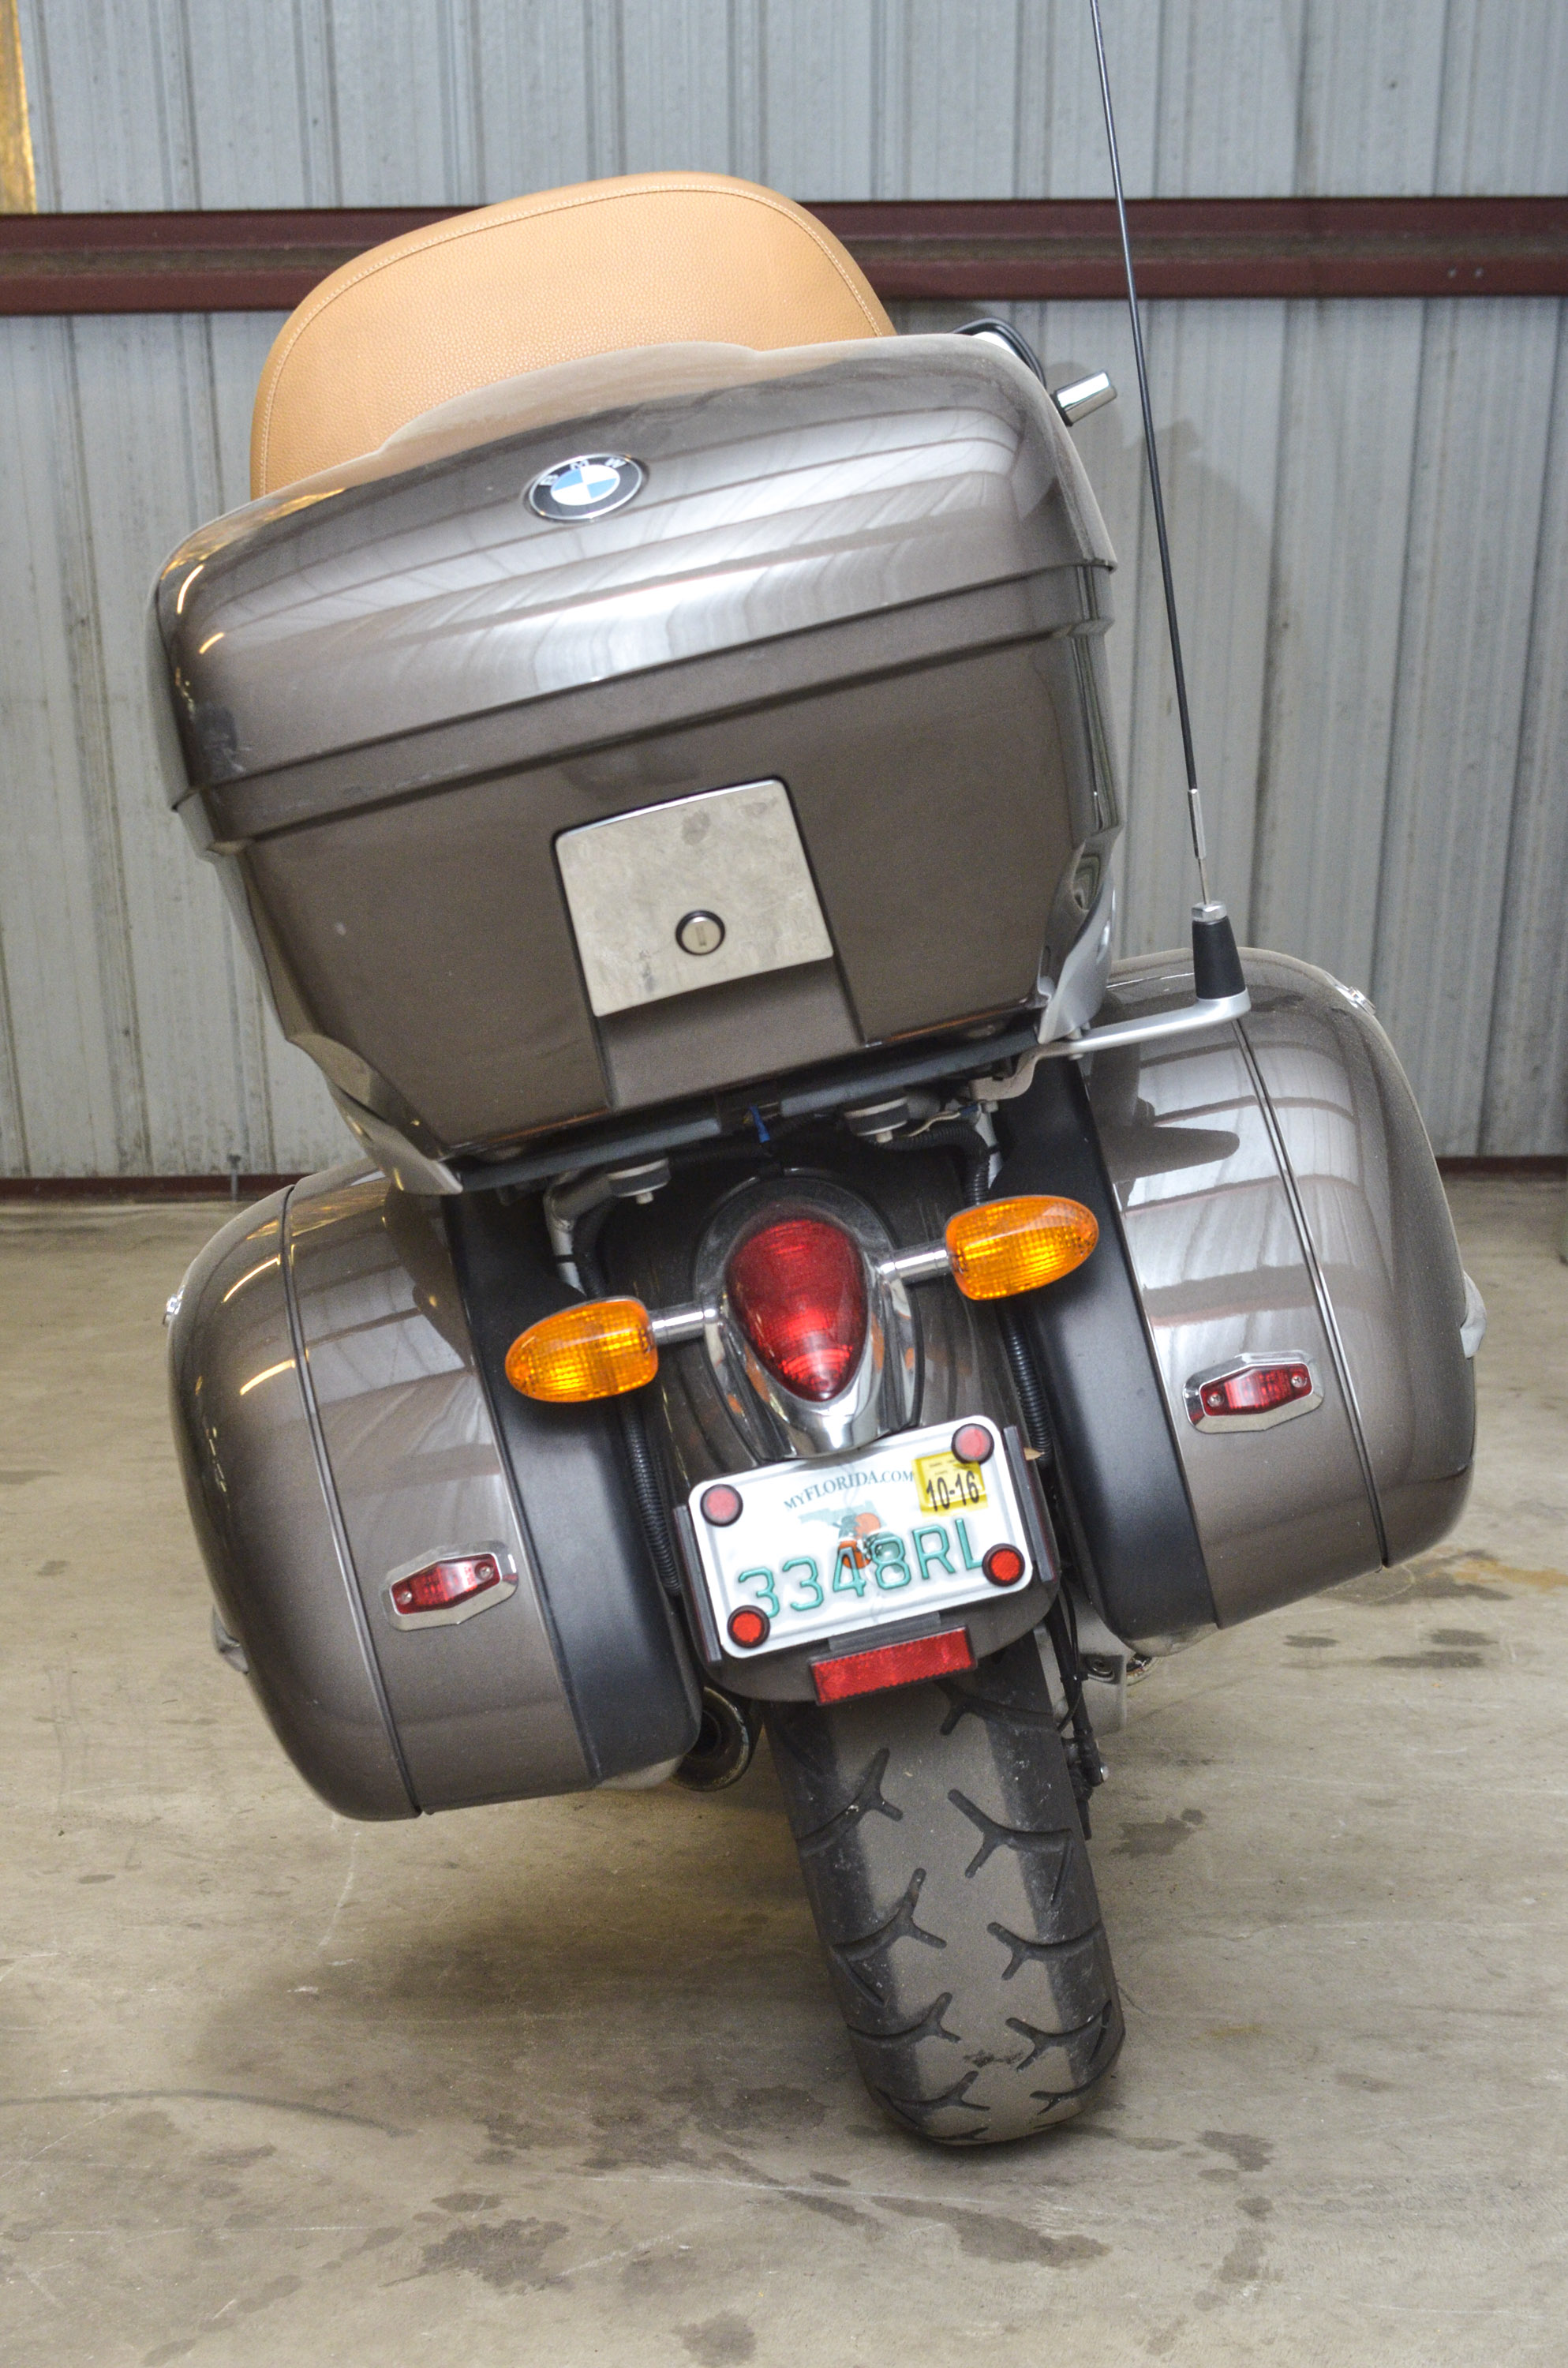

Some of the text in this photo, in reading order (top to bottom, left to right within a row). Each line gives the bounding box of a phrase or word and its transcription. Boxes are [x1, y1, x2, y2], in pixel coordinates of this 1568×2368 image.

[540, 457, 627, 485] BMW
[926, 1471, 979, 1512] 10-16
[738, 1519, 983, 1619] 3348RL
